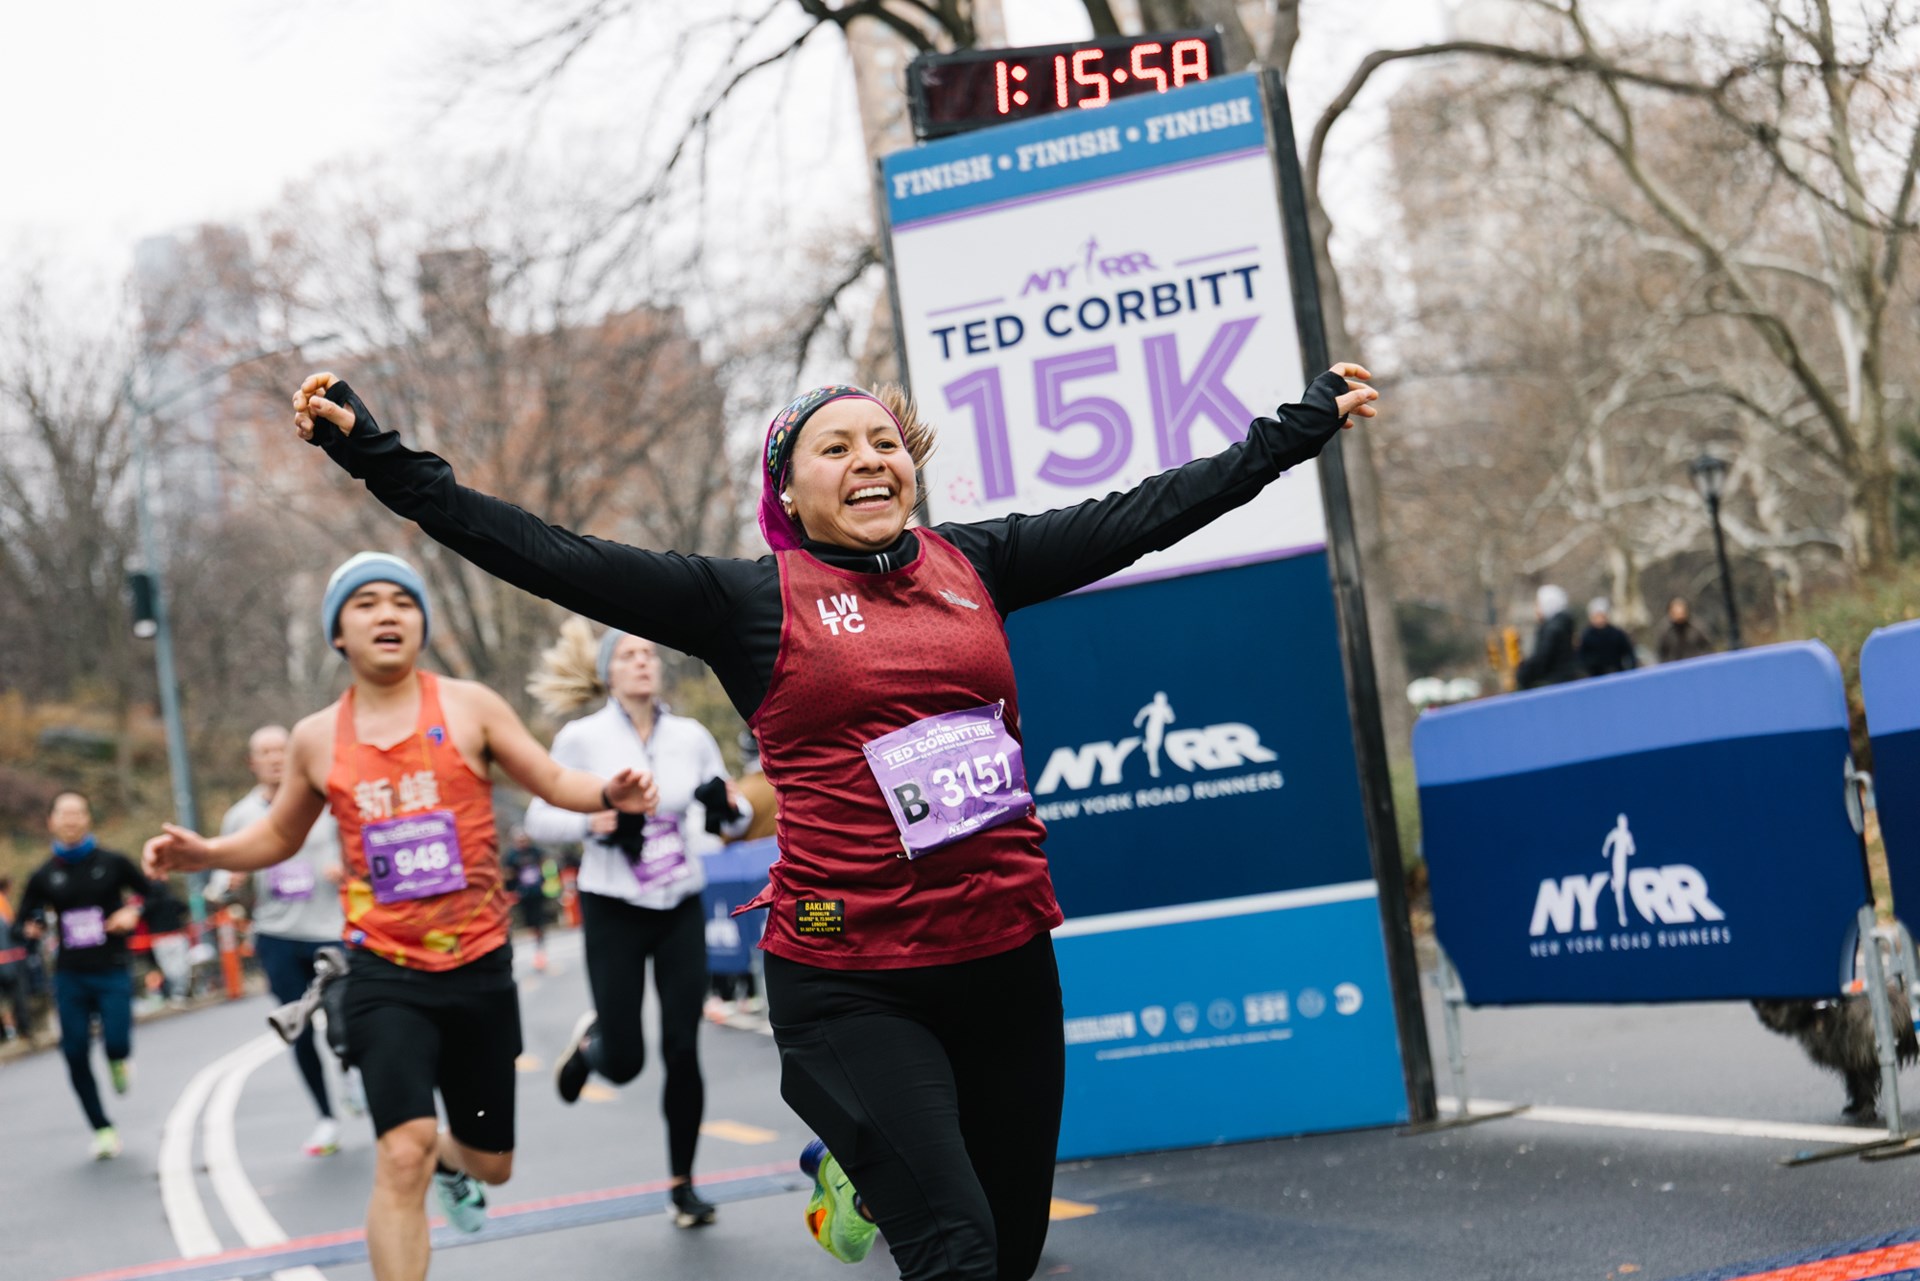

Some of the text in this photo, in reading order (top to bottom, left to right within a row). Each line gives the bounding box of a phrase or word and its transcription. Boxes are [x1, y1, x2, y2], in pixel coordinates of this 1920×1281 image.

[892, 97, 1254, 200] FINISH FINISH FINISH
[930, 264, 1261, 360] TED CORBITT
[942, 314, 1262, 502] 15K
[816, 592, 860, 620] LW
[822, 612, 866, 636] TC
[882, 723, 995, 766] TED CORBITT 15K
[1034, 722, 1279, 795] NYRR
[932, 751, 1013, 808] 3151
[1035, 803, 1081, 822] NEW
[1082, 791, 1135, 816] YORK
[1135, 784, 1191, 809] ROAD
[1192, 770, 1285, 800] RUNNERS
[893, 782, 931, 825] B
[372, 854, 391, 879] D
[394, 842, 450, 876] 948
[804, 901, 836, 911] BAKLINE
[1529, 862, 1726, 937] NYRR
[1529, 926, 1732, 957] NEW YORK ROAD RUNNERS
